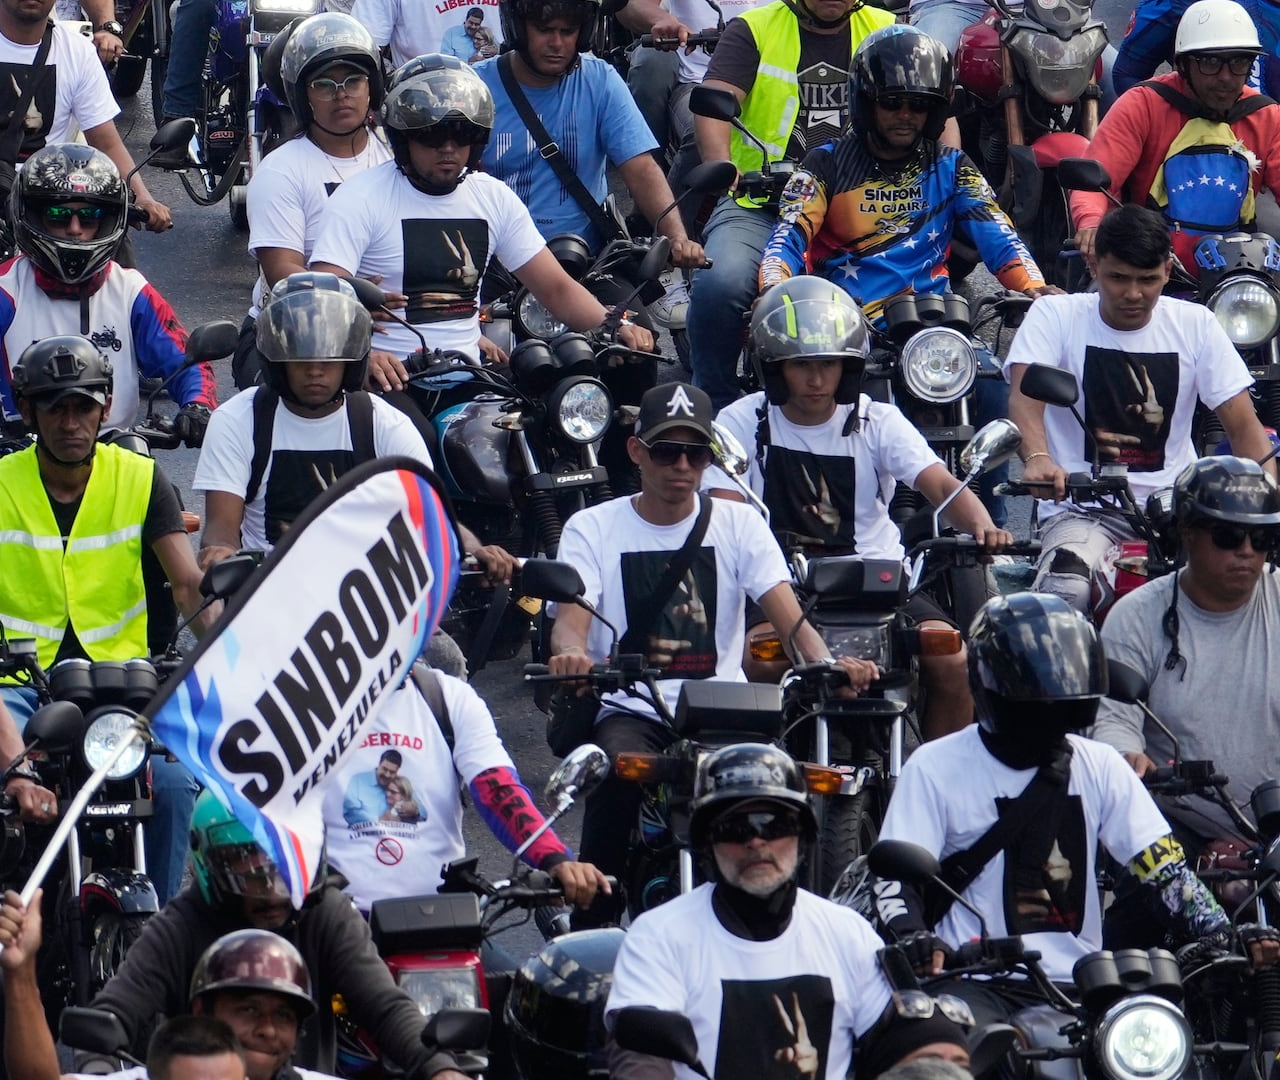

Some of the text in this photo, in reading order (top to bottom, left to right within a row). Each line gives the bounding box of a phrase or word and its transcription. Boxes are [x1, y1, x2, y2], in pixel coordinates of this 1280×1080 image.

[860, 200, 928, 213] LA GUAIRA
[556, 474, 593, 483] BERA
[218, 511, 432, 810] SINBOM
[293, 649, 403, 807] VENEZUELA
[361, 732, 424, 751] BERTAD
[85, 803, 132, 815] KEEWAY
